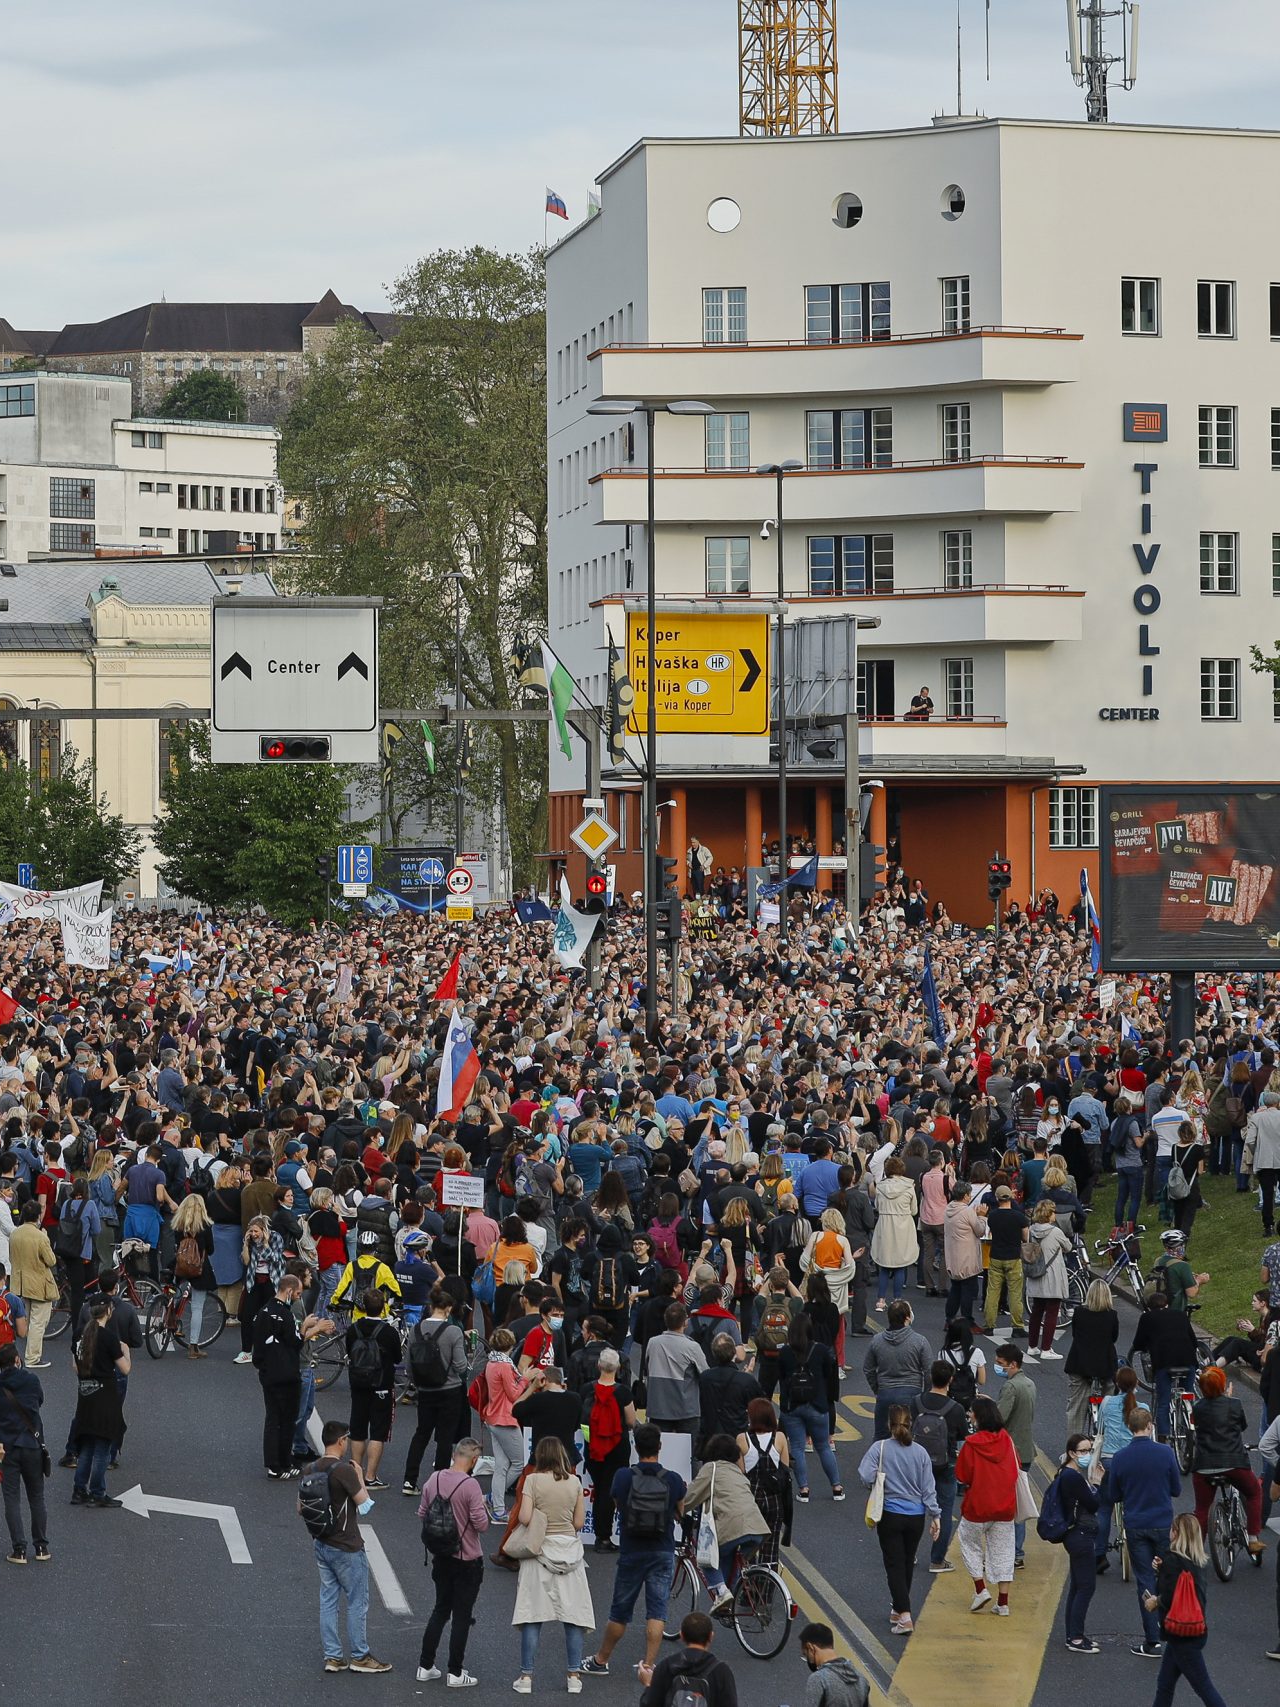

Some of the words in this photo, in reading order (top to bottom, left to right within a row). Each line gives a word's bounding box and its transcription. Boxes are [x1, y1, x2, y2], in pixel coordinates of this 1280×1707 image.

[1132, 463, 1162, 696] TIVOLI
[635, 627, 681, 645] Kper
[267, 659, 321, 674] Center
[635, 655, 699, 669] Hvaška
[710, 657, 725, 669] HR
[635, 679, 681, 696] Itlija
[684, 699, 712, 713] Koper
[1099, 708, 1160, 721] CENTER
[1121, 810, 1144, 819] GRILL
[1113, 826, 1152, 838] SARAJEVSKI
[1183, 847, 1203, 855] GRILL
[400, 863, 417, 871] KAR
[400, 878, 413, 886] NA
[1208, 880, 1233, 903] AVE
